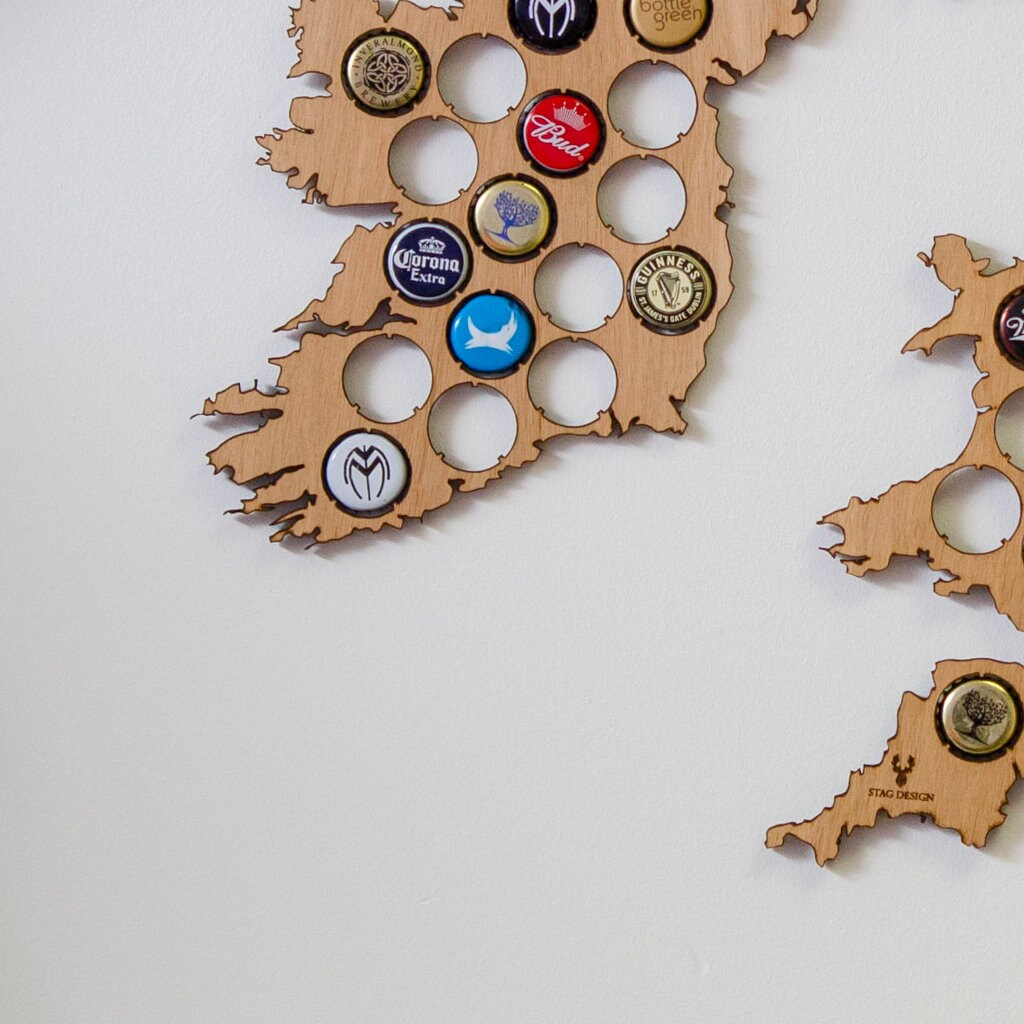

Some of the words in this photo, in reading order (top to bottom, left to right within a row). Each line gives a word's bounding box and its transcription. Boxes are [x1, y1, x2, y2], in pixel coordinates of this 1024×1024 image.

[653, 8, 702, 31] green
[354, 37, 423, 72] INVERALMOND
[354, 81, 417, 107] BREWERY
[530, 114, 590, 156] Bud
[393, 248, 460, 273] Corona
[637, 255, 700, 285] GUINNESS
[410, 268, 445, 285] Extra
[669, 314, 687, 323] GATE
[686, 291, 703, 316] DUBLIN
[868, 788, 894, 799] STAG
[896, 791, 935, 802] DESIGN
